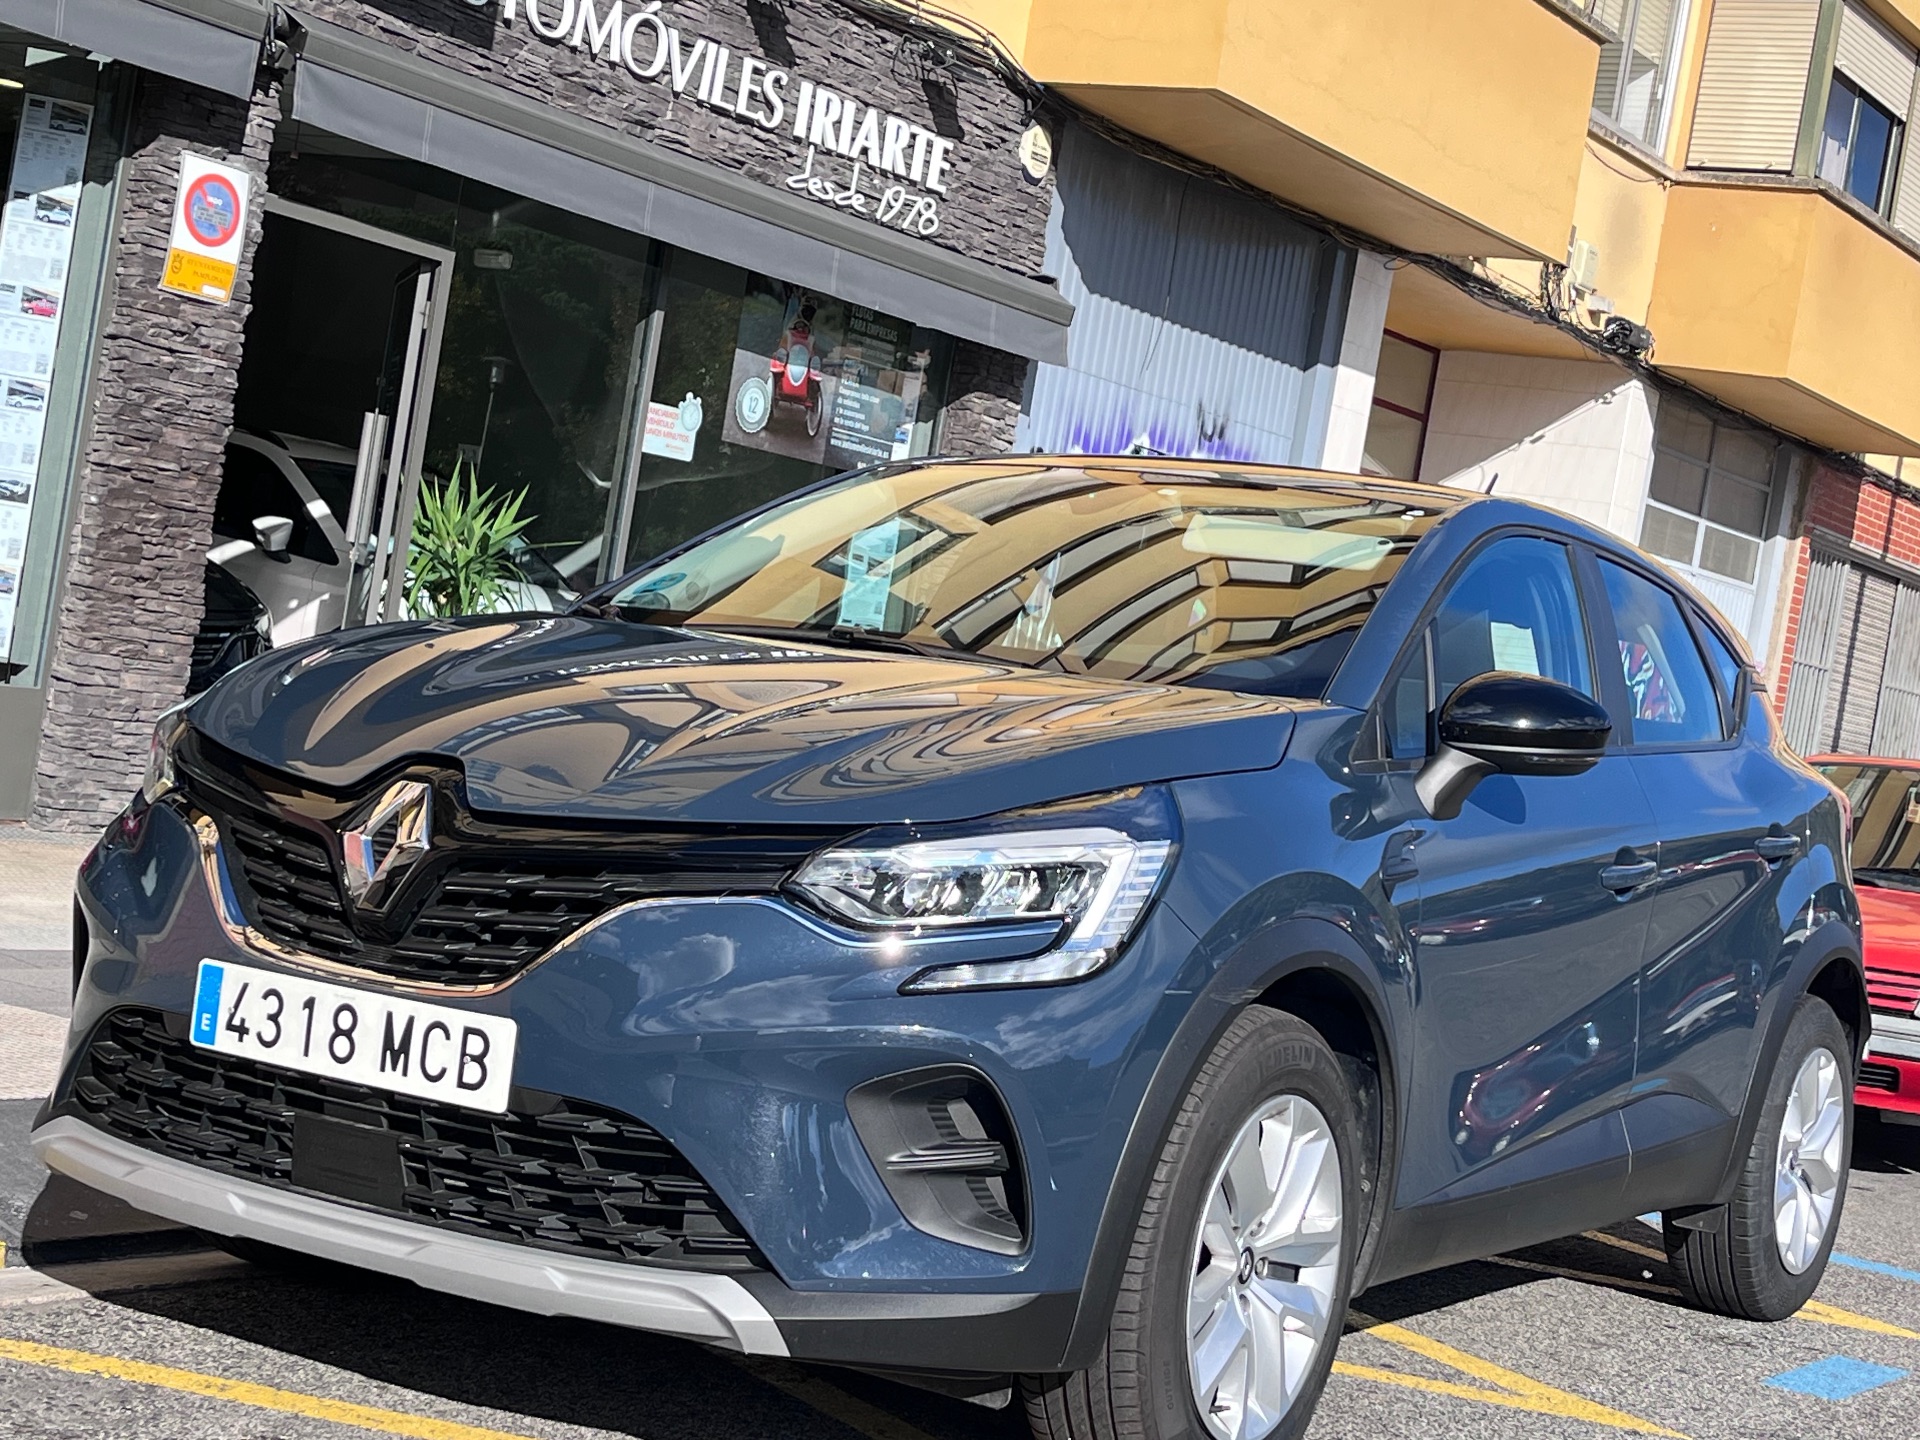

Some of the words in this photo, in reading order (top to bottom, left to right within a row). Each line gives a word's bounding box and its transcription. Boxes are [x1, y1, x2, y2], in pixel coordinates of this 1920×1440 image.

[466, 0, 788, 129] OMÓVILES
[793, 81, 954, 194] IRIARTE
[785, 145, 867, 212] desde
[876, 185, 939, 235] 1978
[849, 318, 866, 332] PARA
[867, 323, 898, 341] EMPRESAS
[749, 396, 759, 414] 12
[200, 1013, 211, 1031] E
[225, 982, 358, 1064] 4318
[379, 1010, 490, 1091] MCB
